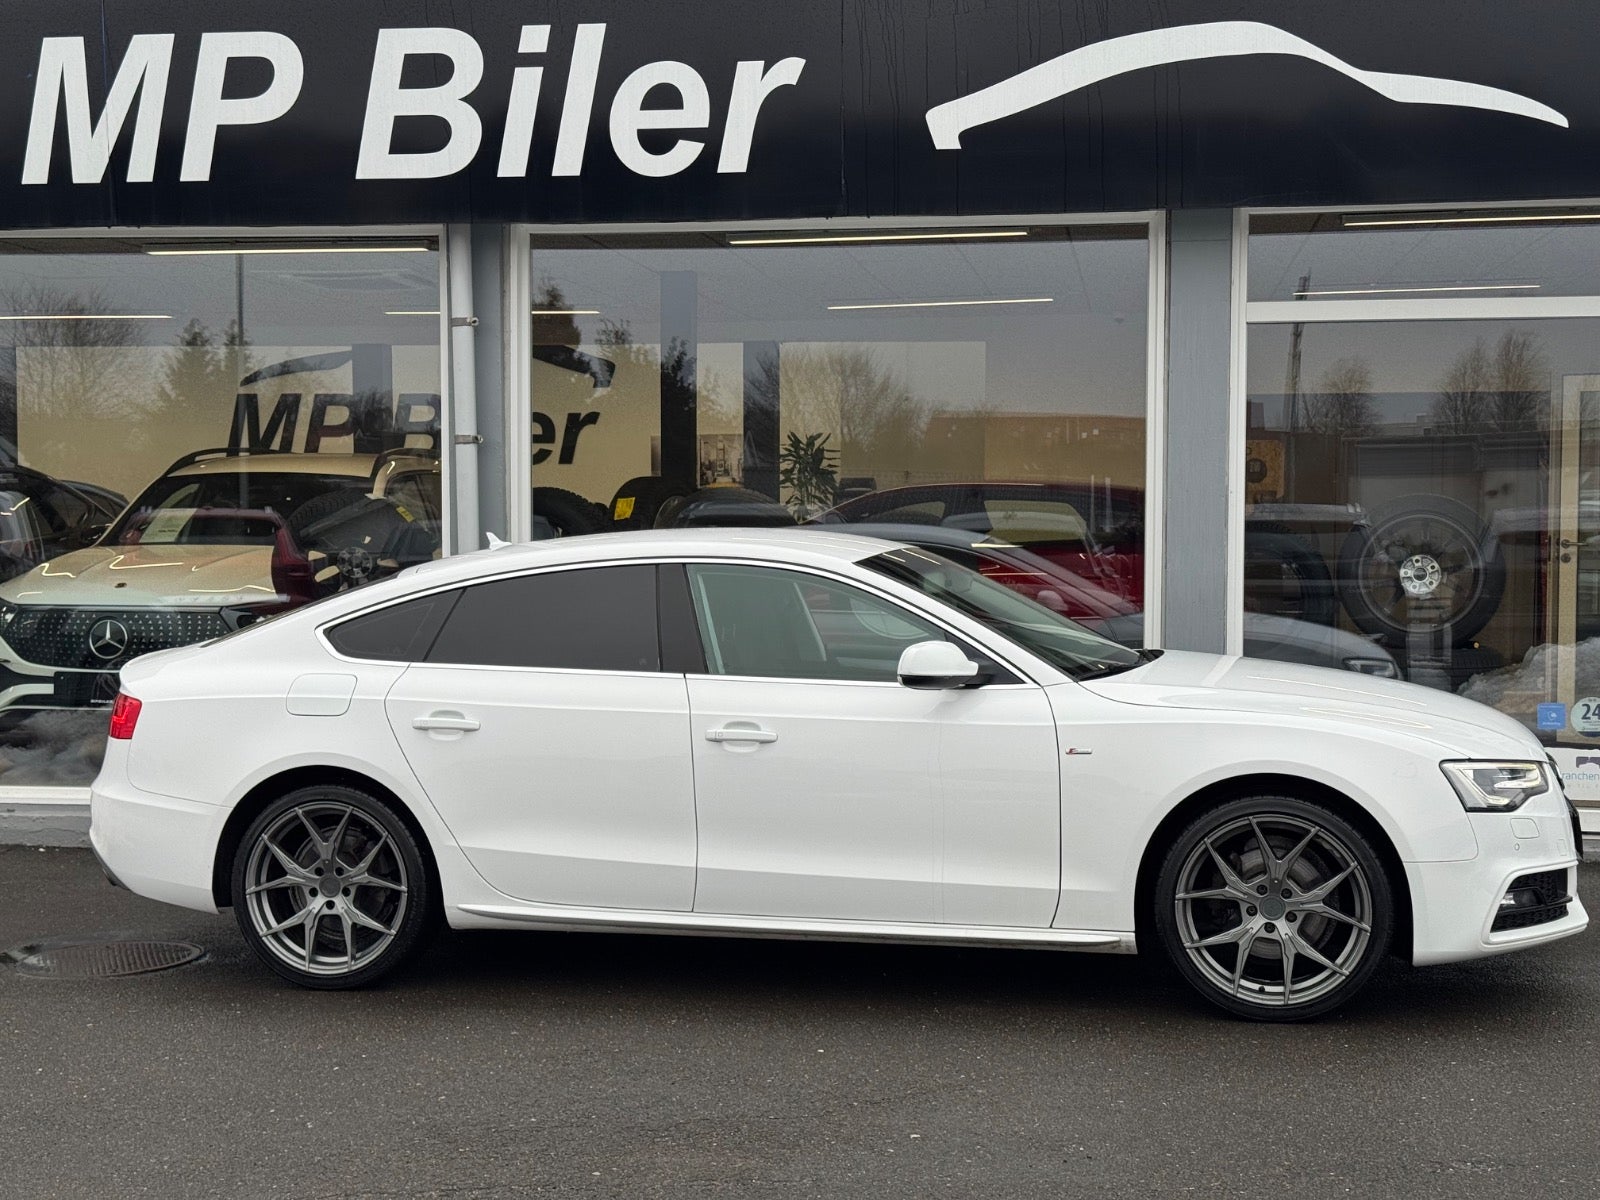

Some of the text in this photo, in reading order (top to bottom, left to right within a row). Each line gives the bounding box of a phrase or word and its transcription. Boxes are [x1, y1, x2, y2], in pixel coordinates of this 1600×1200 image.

[21, 22, 806, 185] MP Biler
[226, 393, 361, 457] MP
[1560, 771, 1600, 781] ranchen
